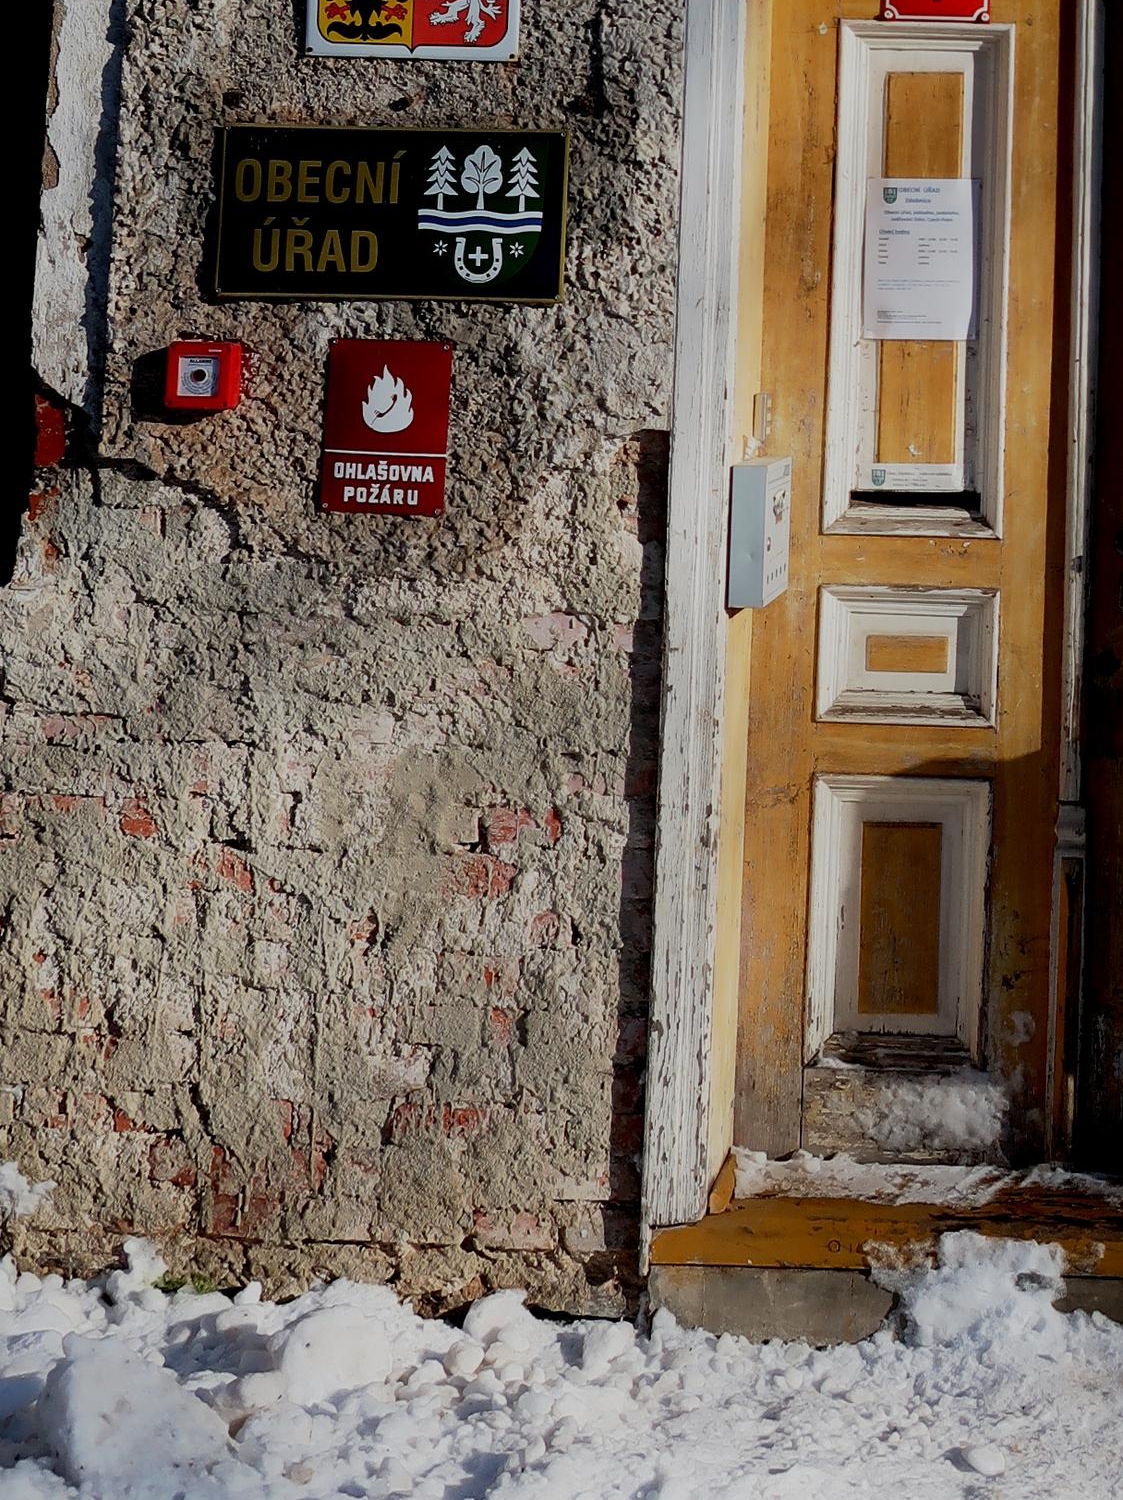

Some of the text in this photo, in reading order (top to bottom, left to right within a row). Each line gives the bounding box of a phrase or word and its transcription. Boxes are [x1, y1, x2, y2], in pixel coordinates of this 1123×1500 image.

[234, 150, 407, 204] OBECNÍ
[252, 216, 379, 273] ÚŘAD
[333, 460, 435, 483] OHLAŠOVNA
[343, 483, 419, 506] POŽÁRU
